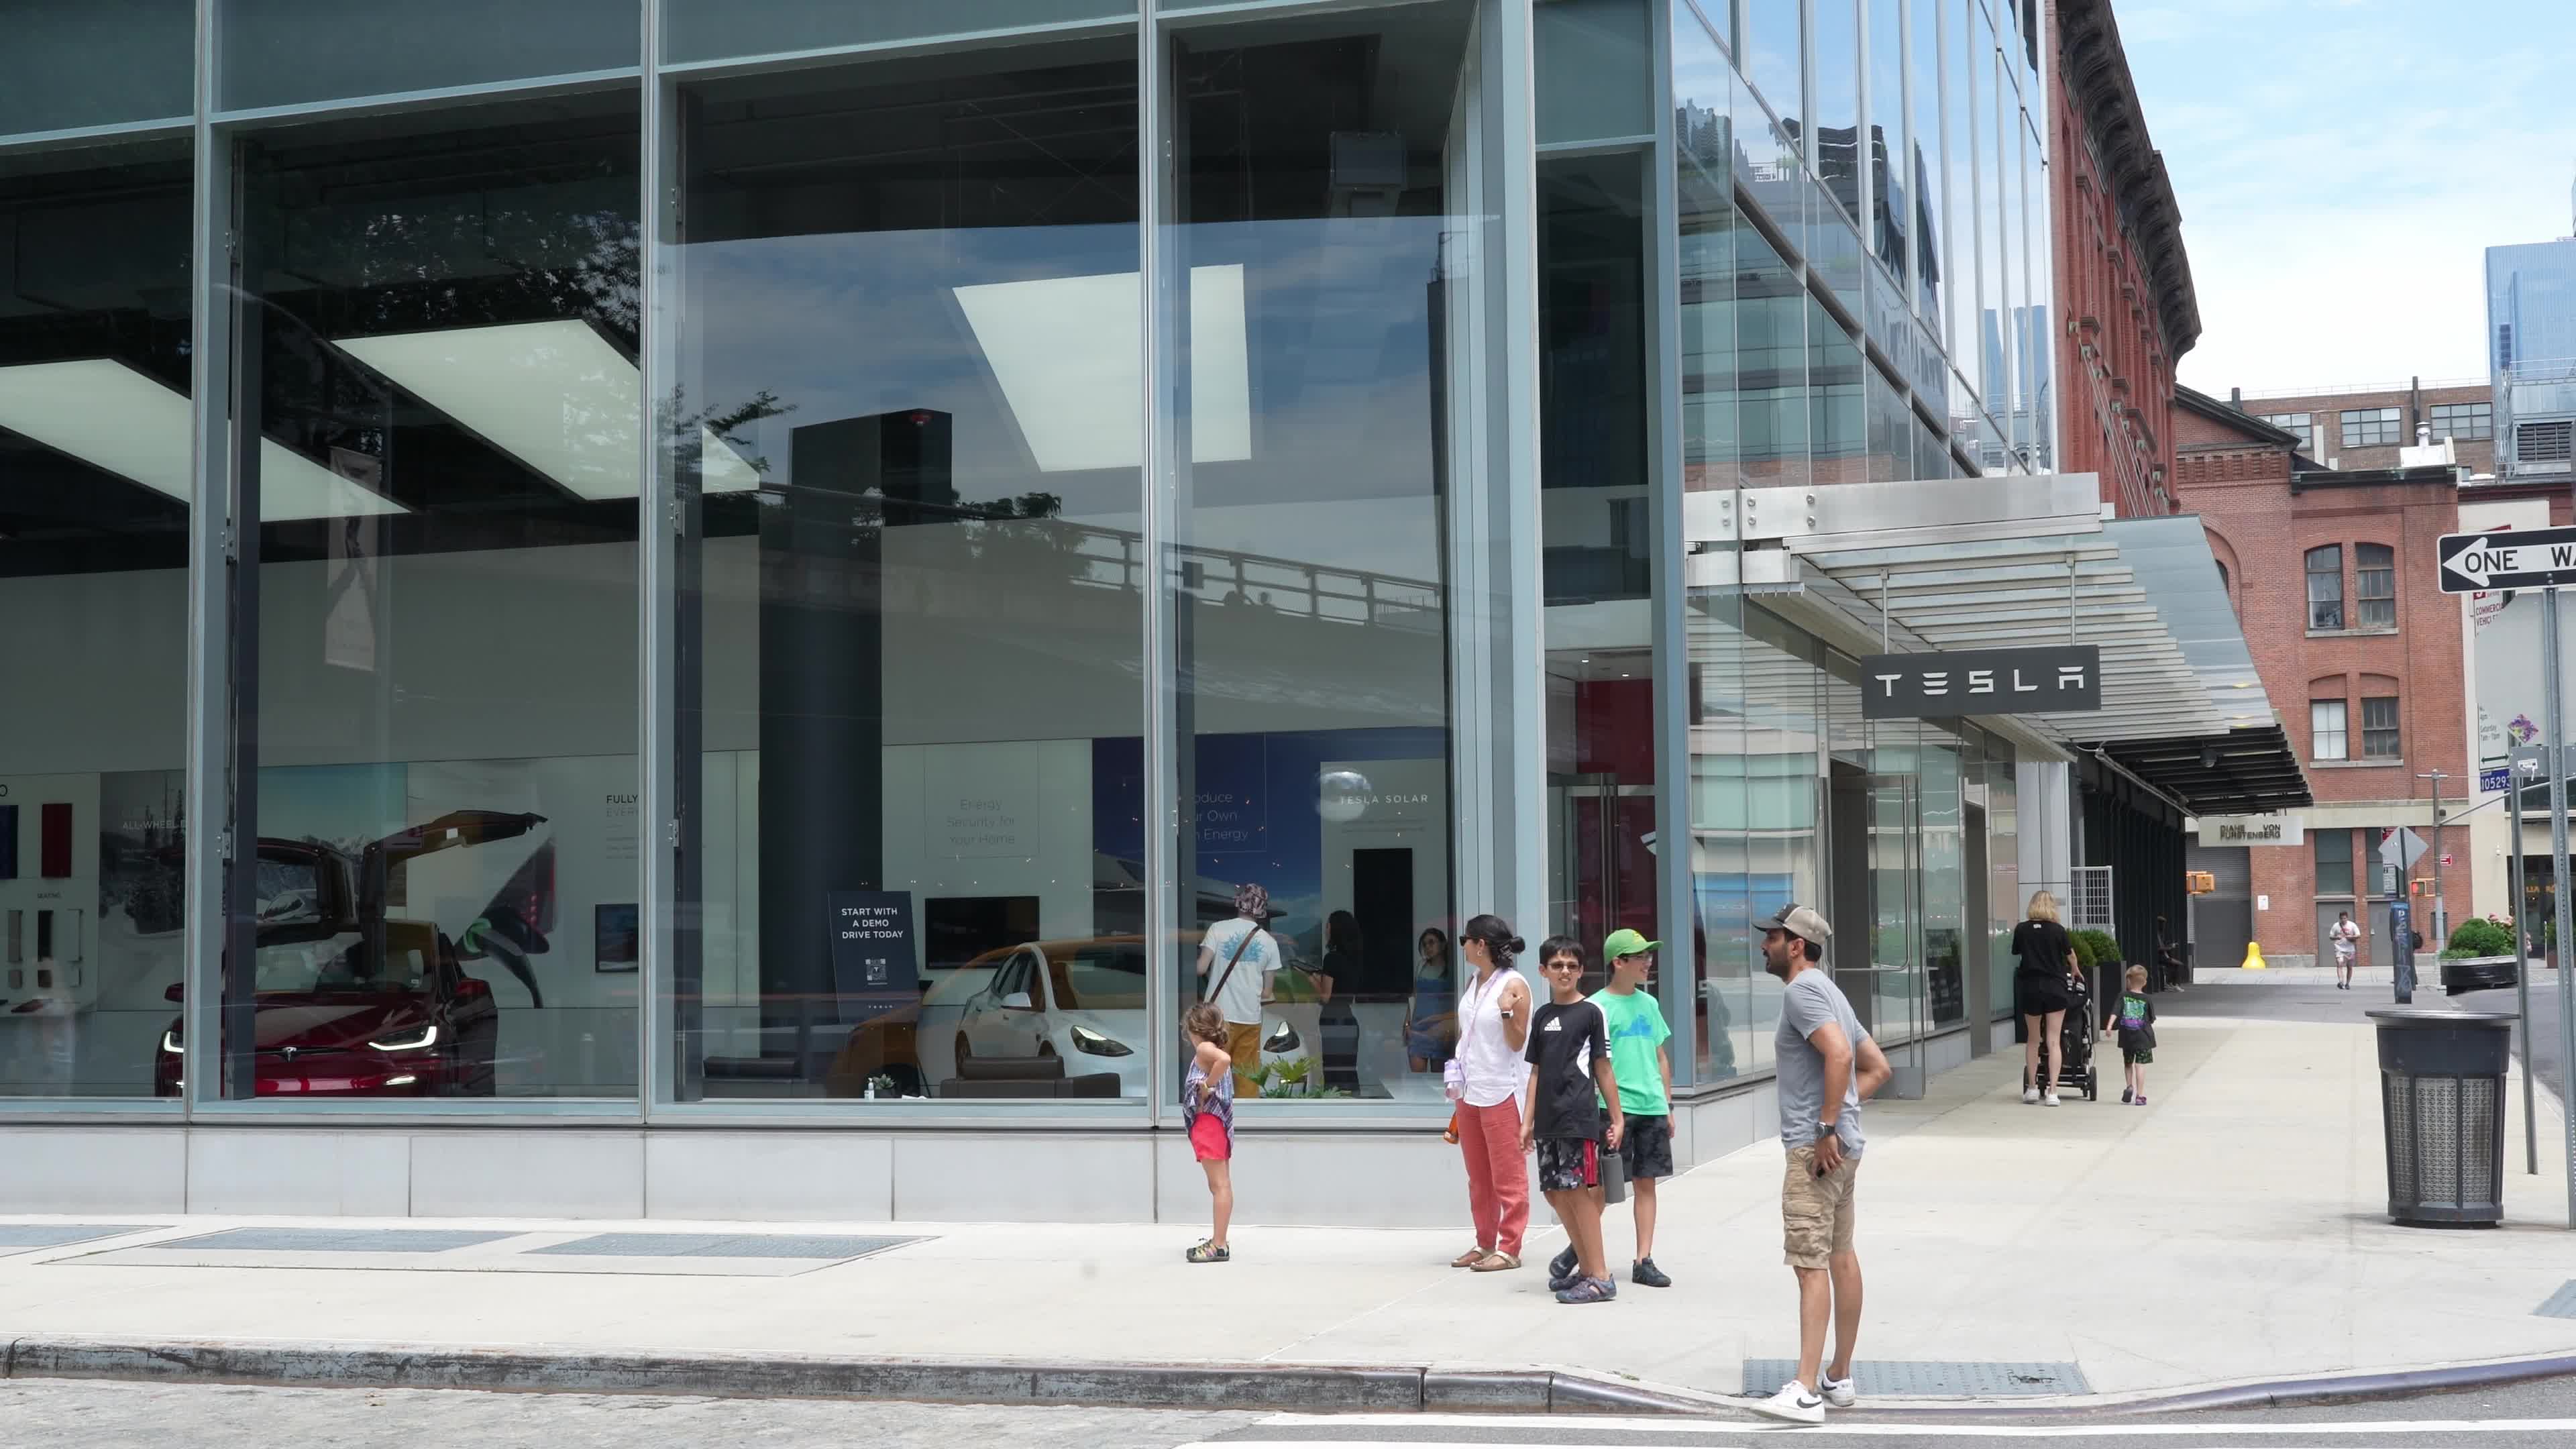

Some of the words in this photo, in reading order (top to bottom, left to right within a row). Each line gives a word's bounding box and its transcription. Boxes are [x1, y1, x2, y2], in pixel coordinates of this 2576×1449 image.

[2465, 549, 2519, 574] ONE
[1875, 666, 2084, 697] TESLA
[606, 794, 638, 804] FULLY
[1194, 790, 1233, 803] oduce
[1340, 795, 1379, 805] TESLA
[1385, 794, 1429, 804] SOLAR
[960, 799, 1003, 812] Energy
[946, 815, 996, 829] Security
[1208, 810, 1238, 822] Own
[2220, 824, 2245, 833] DIANE
[979, 831, 1015, 844] Home
[1204, 828, 1249, 842] Energy
[2220, 831, 2281, 839] FURSTENBERG
[841, 908, 871, 916] START
[873, 908, 898, 916] WITH
[853, 920, 859, 928] A
[862, 919, 889, 927] DEMO
[842, 931, 871, 939] DRIVE
[873, 930, 903, 938] TODAY
